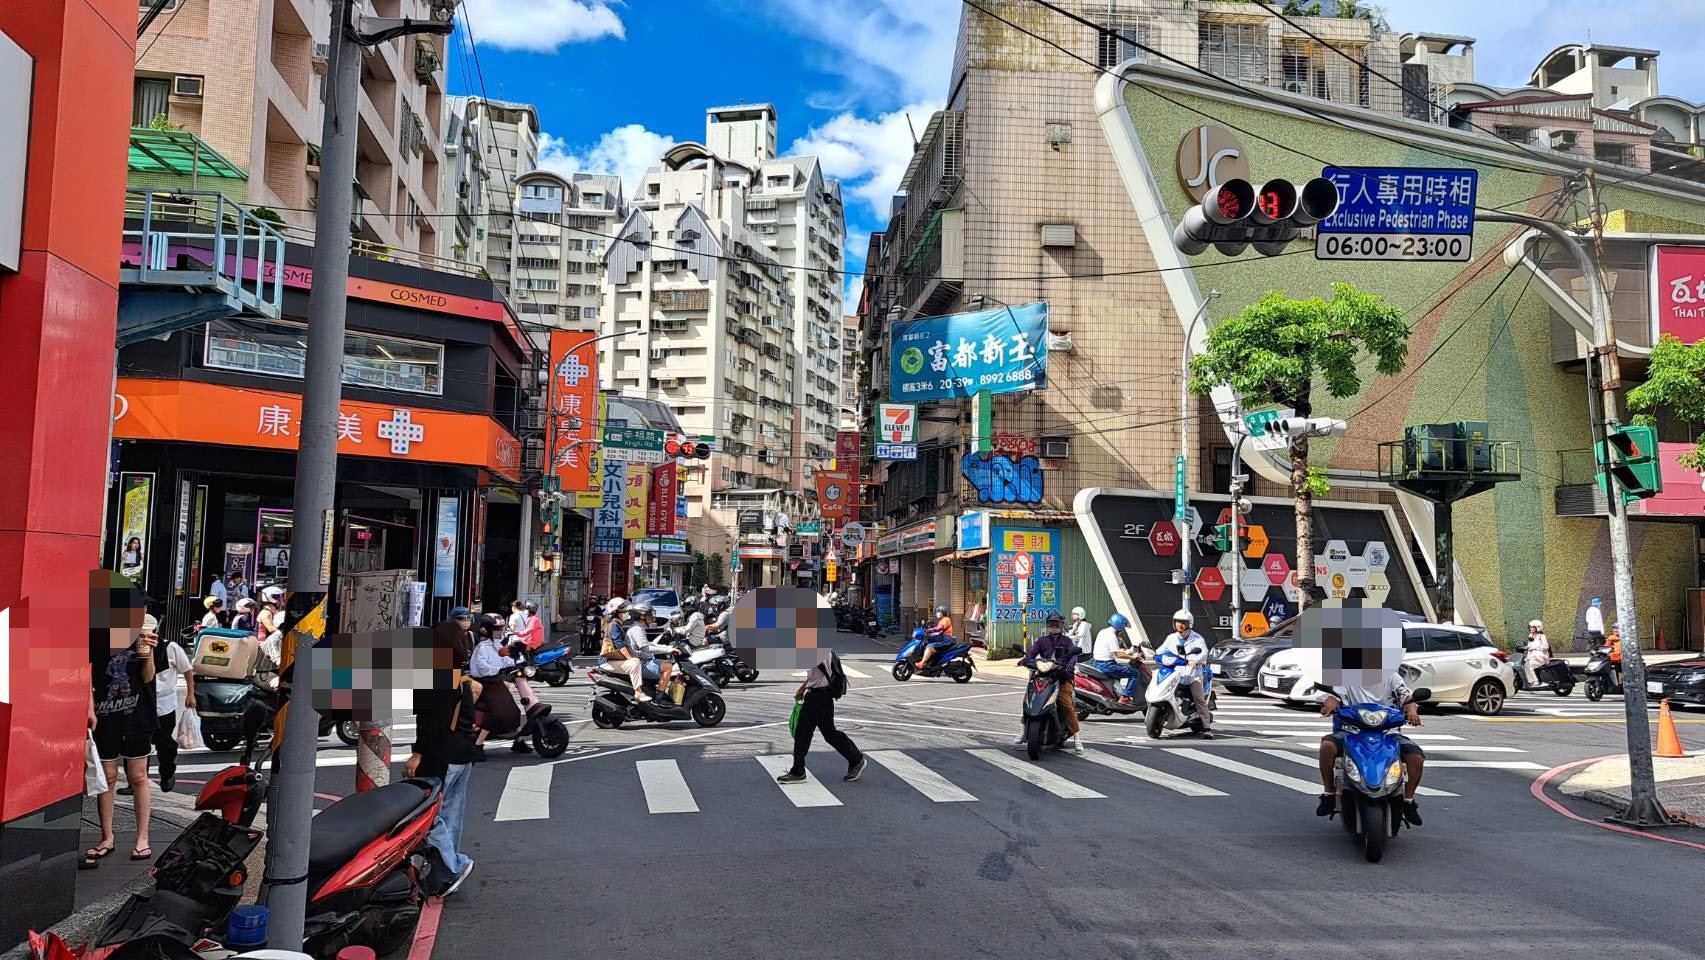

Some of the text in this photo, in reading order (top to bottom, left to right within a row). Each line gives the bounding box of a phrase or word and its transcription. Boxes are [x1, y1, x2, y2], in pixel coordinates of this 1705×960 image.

[1330, 173, 1471, 206] 行人專用時相
[1324, 209, 1468, 229] Exclusive Pedestrian Phase
[1326, 236, 1462, 257] 06:00~23:00
[263, 264, 312, 285] COSME
[390, 288, 447, 307] COSMED
[1672, 306, 1697, 318] THAI
[928, 332, 1035, 372] 富都新玉
[980, 373, 1003, 385] 8992
[1006, 370, 1032, 382] 6888
[257, 404, 362, 444] 康美
[624, 430, 656, 442] 幸福路
[599, 461, 622, 525] 文小兒科
[823, 503, 842, 511] CoCo
[1124, 523, 1145, 535] 2F
[997, 561, 1015, 605] 紅豆湯
[996, 608, 1058, 620] 2277-801
